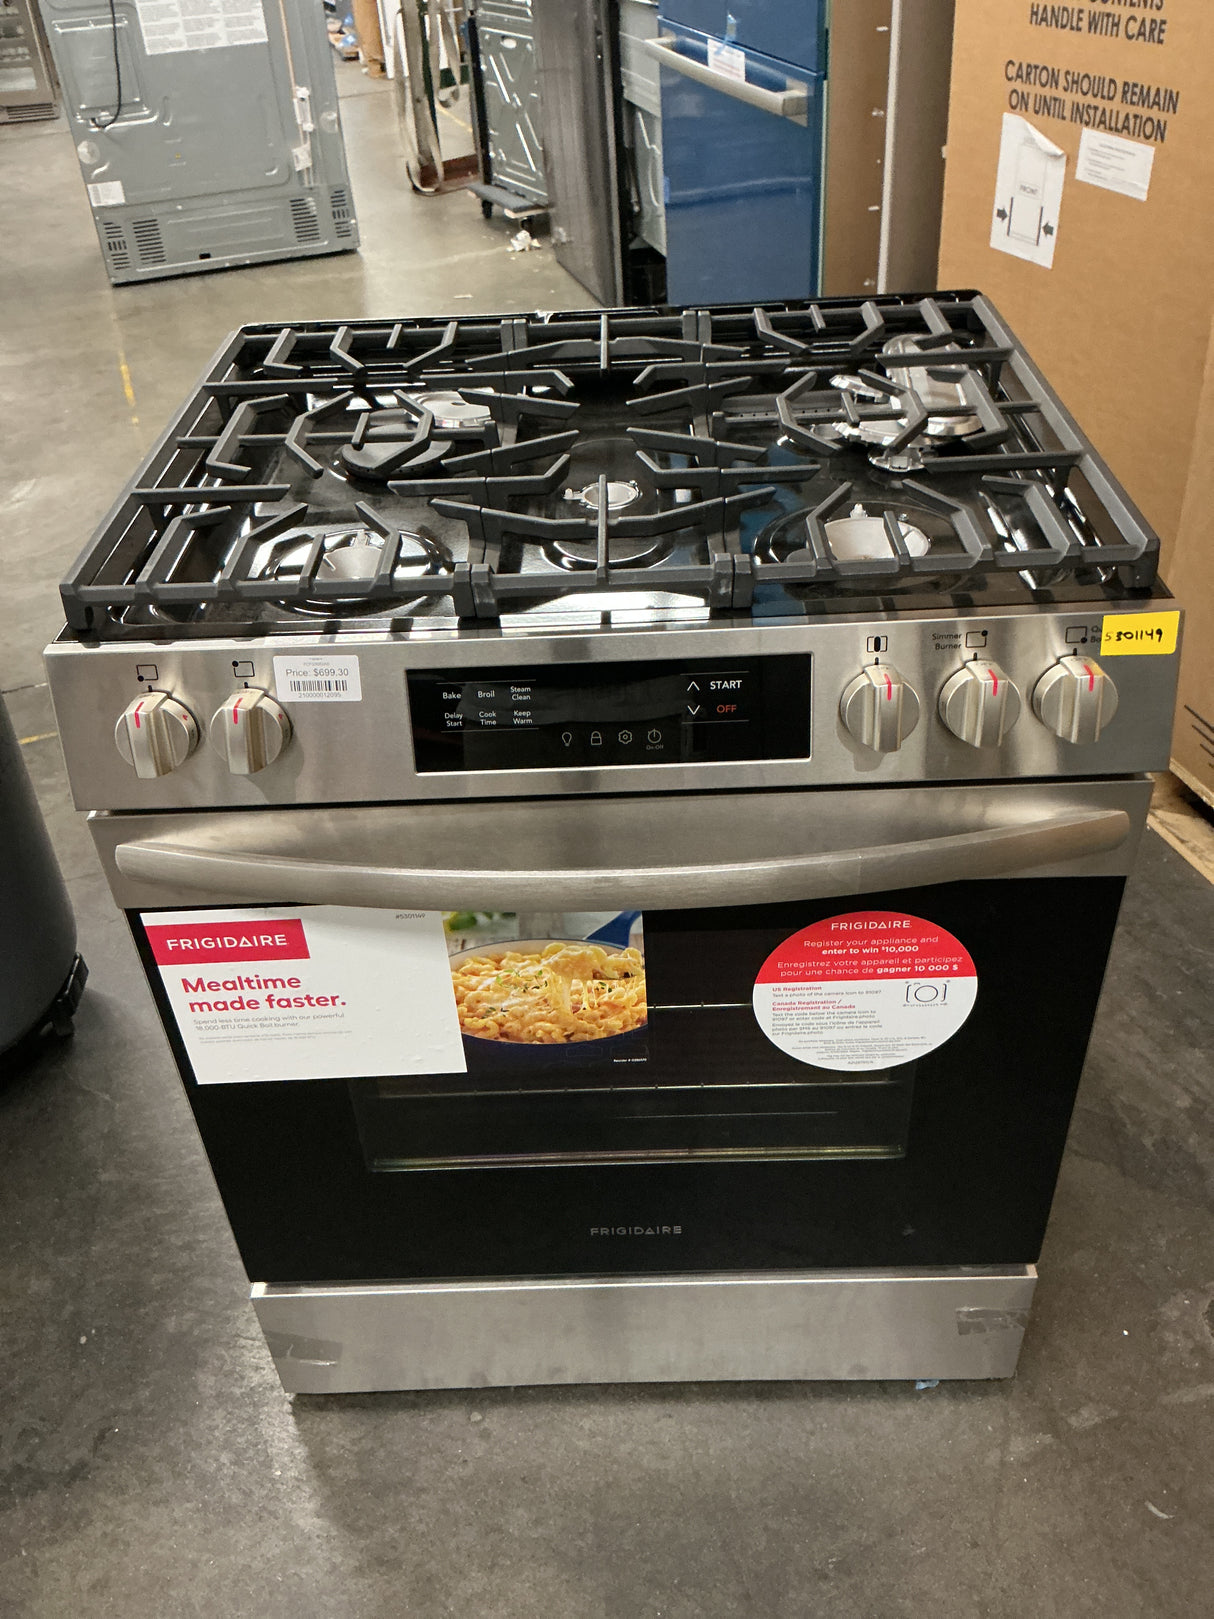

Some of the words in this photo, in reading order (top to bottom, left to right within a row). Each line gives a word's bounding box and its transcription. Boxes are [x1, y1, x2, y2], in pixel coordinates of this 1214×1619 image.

[1030, 4, 1083, 33] HANDLE
[1088, 10, 1120, 38] WITH
[1125, 15, 1167, 45] CARE
[1005, 59, 1060, 90] CARTON
[1063, 70, 1117, 101] SHOULD
[1121, 80, 1180, 115] REMAIN
[1009, 88, 1030, 112] ON
[1033, 93, 1066, 121] UNTIL
[1070, 101, 1168, 144] INSTALLATION
[286, 668, 310, 677] Price:
[313, 668, 349, 677] $699.30
[510, 686, 531, 694] Steam
[710, 680, 742, 690] START
[442, 691, 462, 700] Bake
[477, 690, 495, 699] Broil
[511, 693, 531, 701] Clean
[716, 704, 737, 713] OFF
[444, 712, 463, 720] Delay
[514, 710, 531, 718] Keep
[480, 718, 497, 726] Time
[512, 717, 533, 725] Warm
[831, 920, 910, 931] FRIGIDAIRE
[166, 934, 288, 951] FRIGIDAIRE
[803, 939, 844, 948] Register
[845, 939, 868, 947] your
[870, 937, 917, 946] appliance
[881, 945, 919, 954] $10,000
[777, 960, 831, 969] Enregistrez
[860, 957, 899, 966] appareil
[914, 955, 963, 965] participez
[780, 969, 803, 977] pour
[825, 967, 860, 975] chance
[861, 966, 874, 974] de
[876, 965, 911, 974] gagner
[952, 963, 959, 971] $
[181, 974, 302, 993] Mealtime
[189, 996, 260, 1013] made
[265, 994, 346, 1009] faster.
[590, 1226, 683, 1236] FRIGIDAIRE
